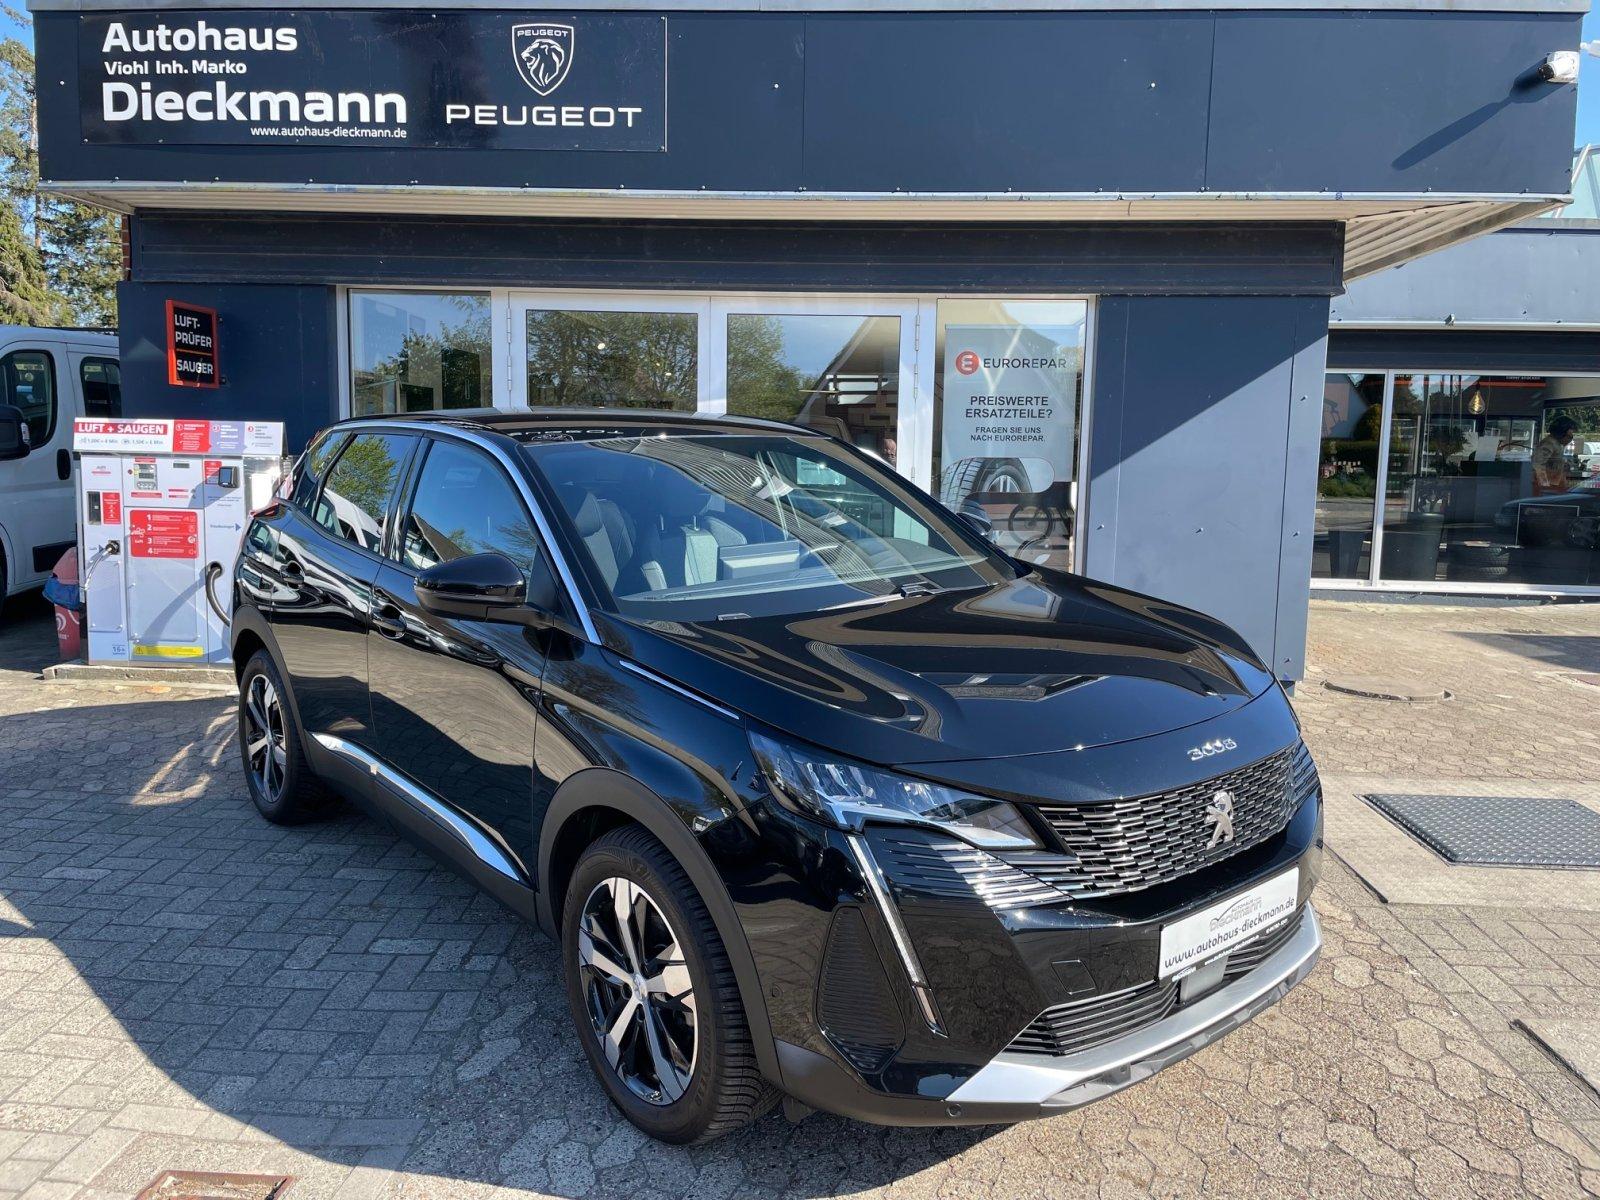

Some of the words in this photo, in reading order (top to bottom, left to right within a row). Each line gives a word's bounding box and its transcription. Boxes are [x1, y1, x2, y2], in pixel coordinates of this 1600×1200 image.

[102, 21, 298, 52] Autohaus
[517, 29, 569, 37] PEUGEOT
[104, 61, 148, 75] Viohl
[155, 60, 189, 74] Inh.
[192, 60, 247, 74] Marko
[102, 81, 407, 124] Dieckmann
[446, 104, 642, 128] PEUGEOT
[250, 126, 408, 139] www.autohaus-dieckmann.de
[174, 314, 201, 329] LUFT-
[175, 331, 212, 348] PRÜFER
[176, 359, 214, 375] SAUGER
[983, 358, 1067, 369] EUROREPAR
[970, 396, 1049, 406] PREISWERTE
[965, 408, 1053, 419] ERSATZTEILE?
[78, 423, 105, 432] LUFT
[117, 424, 164, 434] SAUGEN
[975, 426, 1008, 434] FRAGEN
[1010, 426, 1022, 434] SIE
[1024, 426, 1042, 434] UNS
[970, 434, 993, 442] NACH
[1187, 739, 1237, 761] 3008
[1164, 897, 1296, 968] www.autohaus-dieckmann.de
